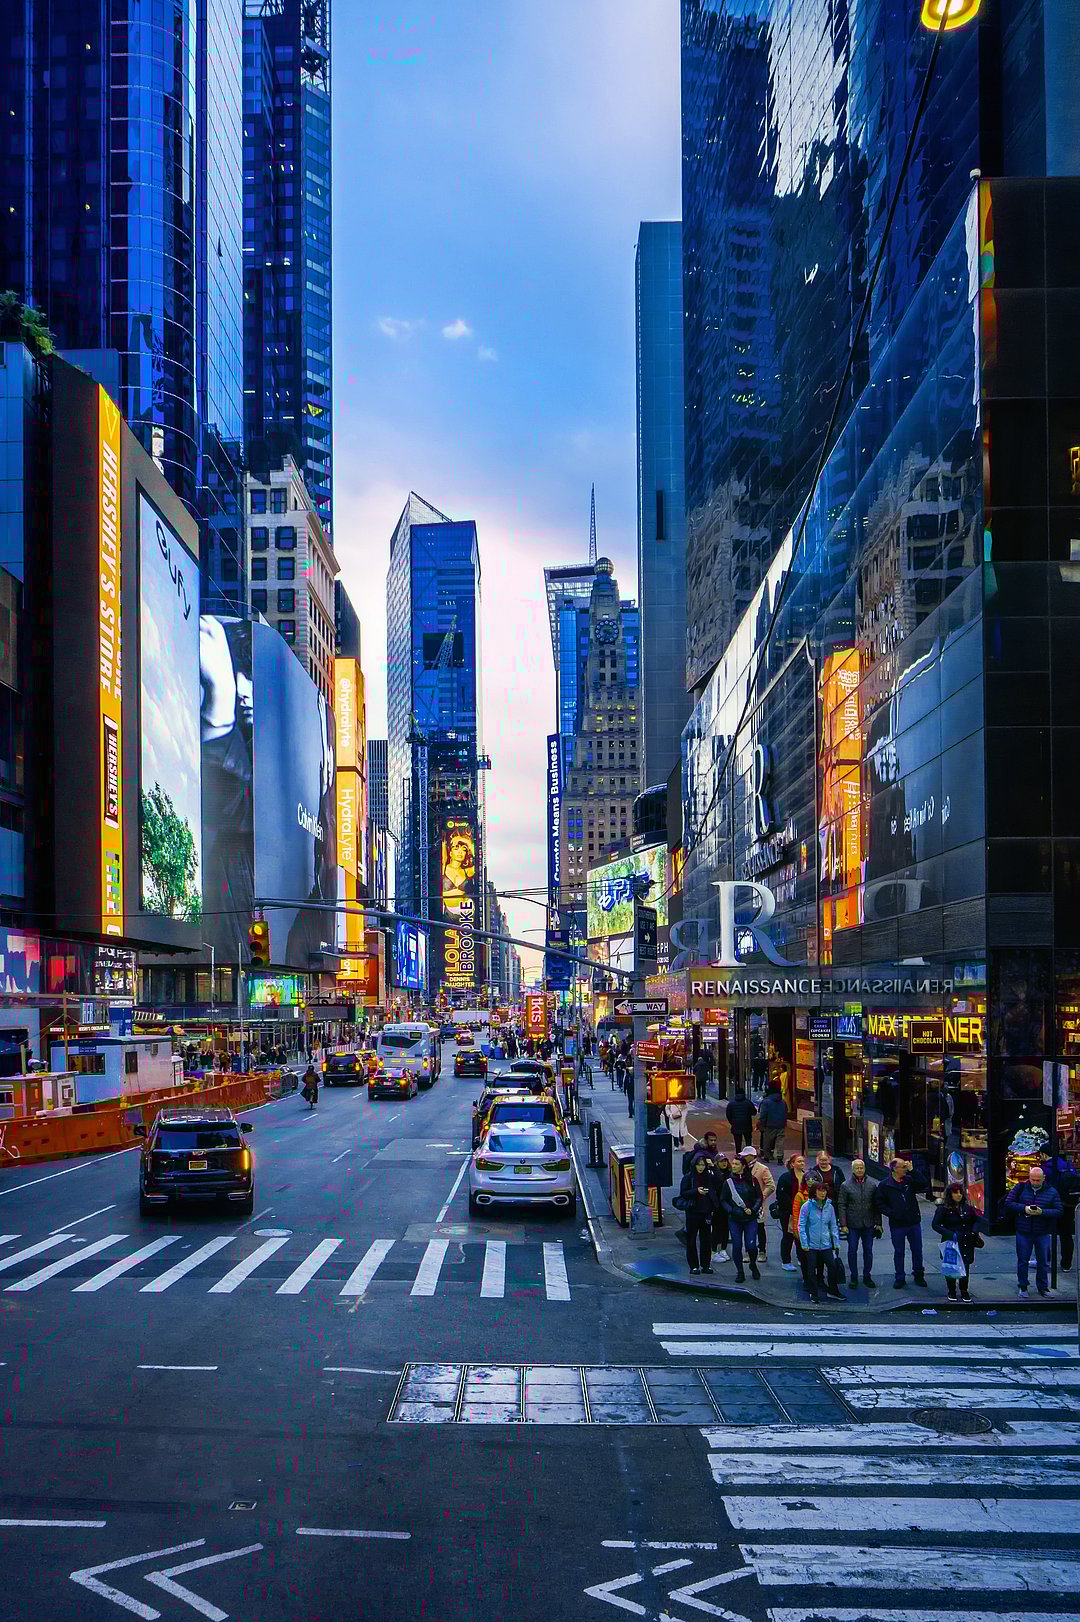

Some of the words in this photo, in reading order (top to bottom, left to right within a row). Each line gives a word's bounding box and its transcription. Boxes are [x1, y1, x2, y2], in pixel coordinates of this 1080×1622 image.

[101, 440, 118, 599] HERSHEY'S
[100, 599, 115, 694] STORE
[550, 740, 558, 794] Business
[551, 796, 560, 837] Means
[445, 928, 459, 972] LOLA
[460, 899, 475, 972] BROOKE
[646, 1003, 664, 1011] WAY
[691, 979, 822, 995] RENAISSANCE
[868, 1014, 897, 1037] MAX
[903, 1014, 983, 1045] BNER
[922, 1030, 933, 1038] HOT
